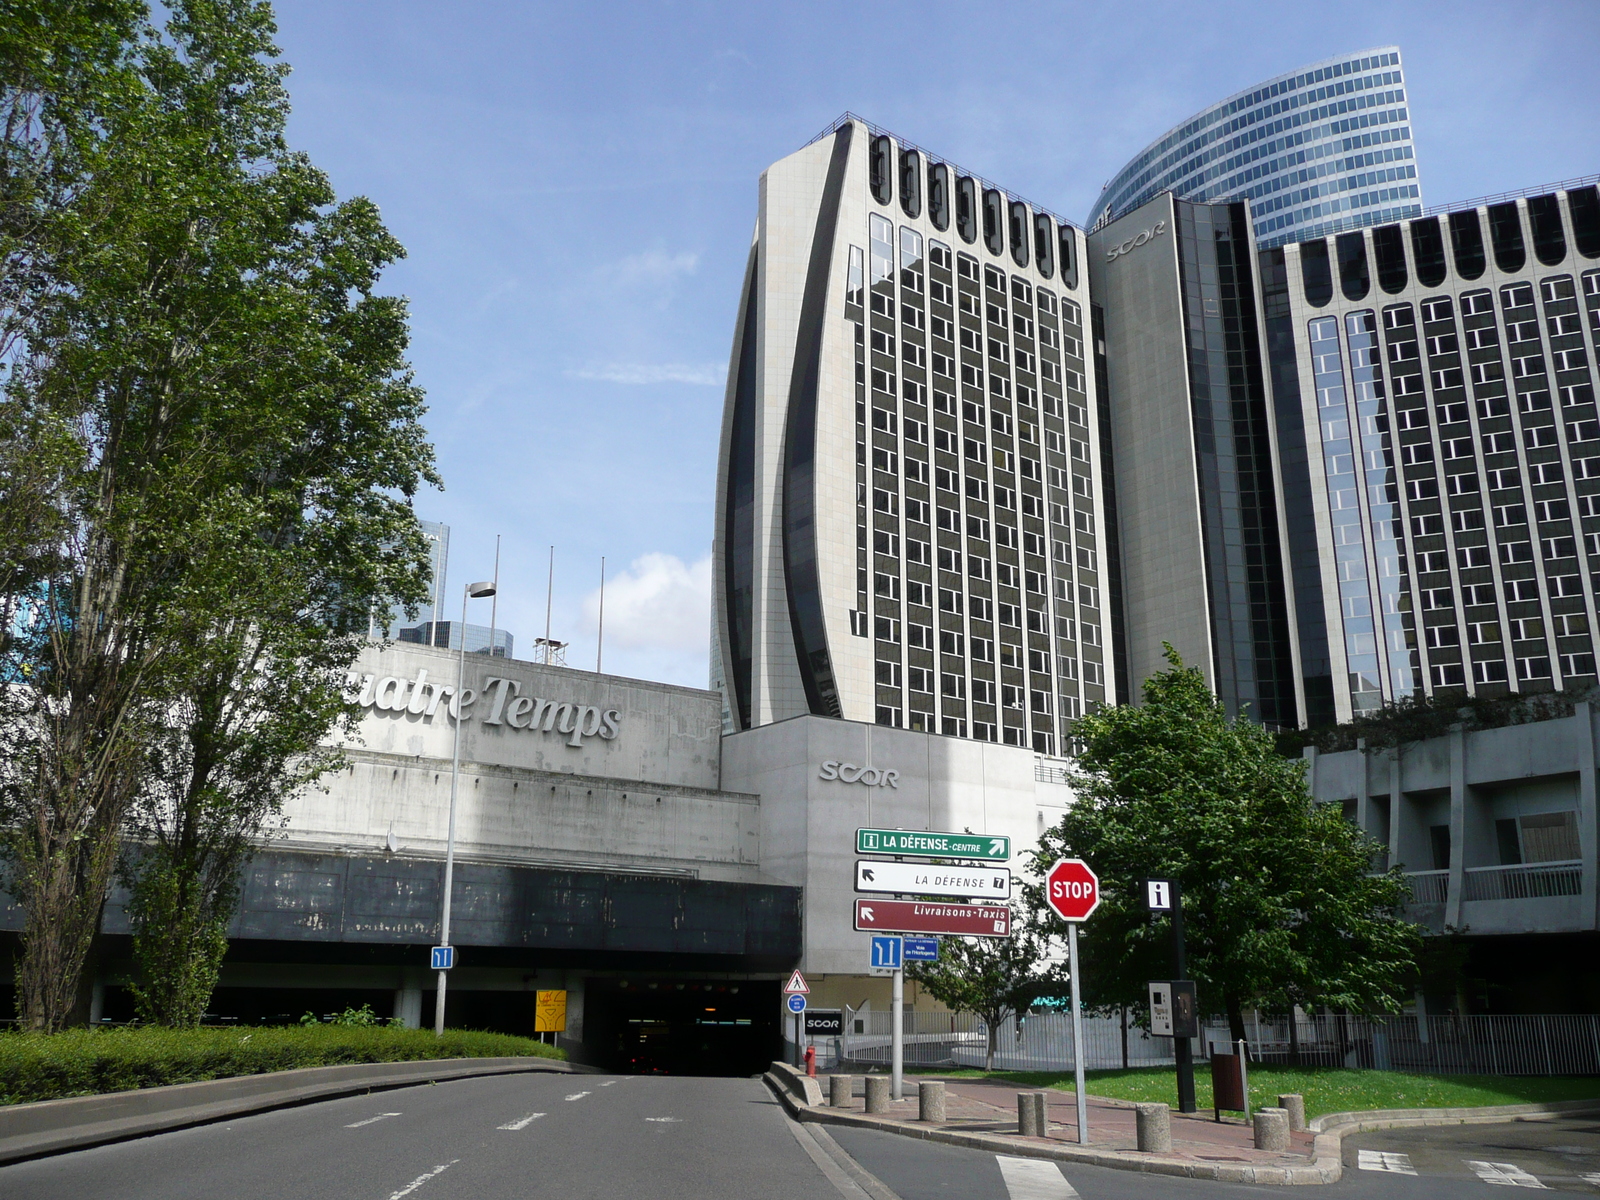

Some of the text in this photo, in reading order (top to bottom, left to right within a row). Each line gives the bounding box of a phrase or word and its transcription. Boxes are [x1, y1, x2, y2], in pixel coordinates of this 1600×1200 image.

[1106, 220, 1166, 263] SCOR
[345, 668, 622, 748] uatre Temps
[819, 760, 900, 789] SCOR
[883, 835, 897, 848] LA
[915, 875, 928, 885] LA
[934, 874, 985, 888] DÉFENSE
[1053, 881, 1093, 899] STOP
[806, 1019, 840, 1028] SCOR
